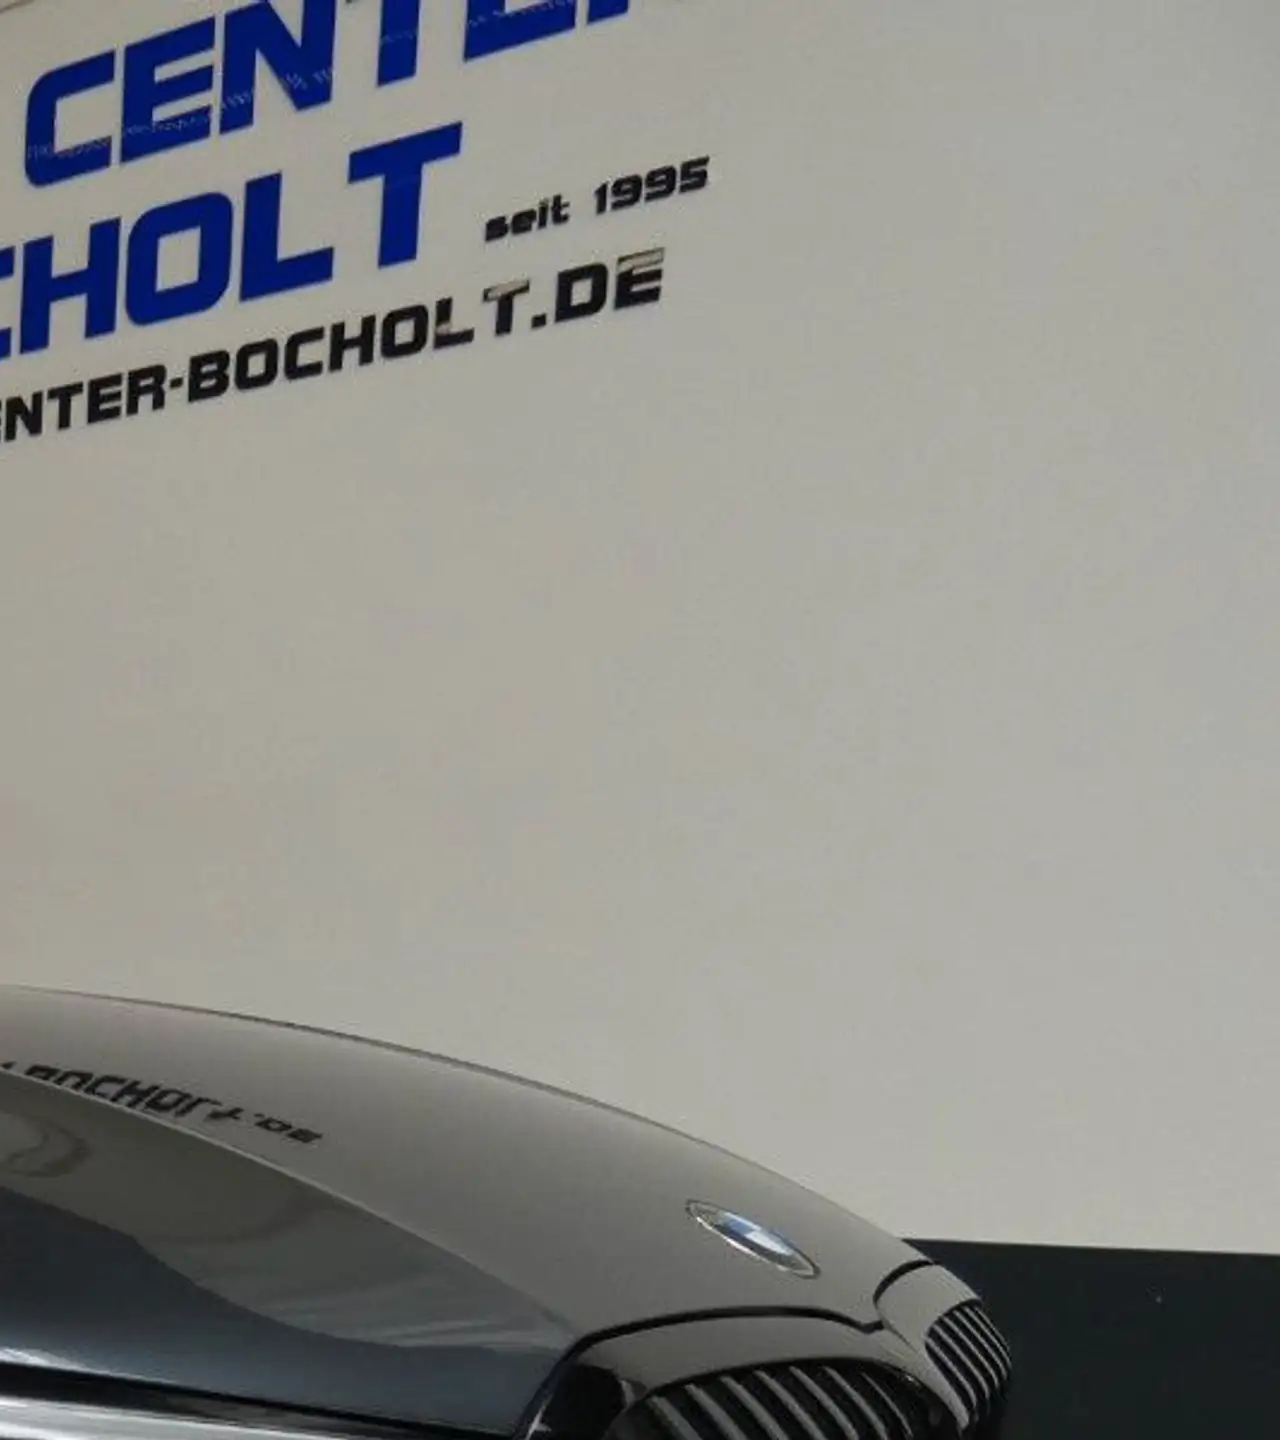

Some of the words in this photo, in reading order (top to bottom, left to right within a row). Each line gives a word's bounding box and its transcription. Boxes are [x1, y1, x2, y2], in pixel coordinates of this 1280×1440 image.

[25, 0, 629, 187] CENT
[484, 194, 571, 243] seit
[594, 155, 710, 215] 1995
